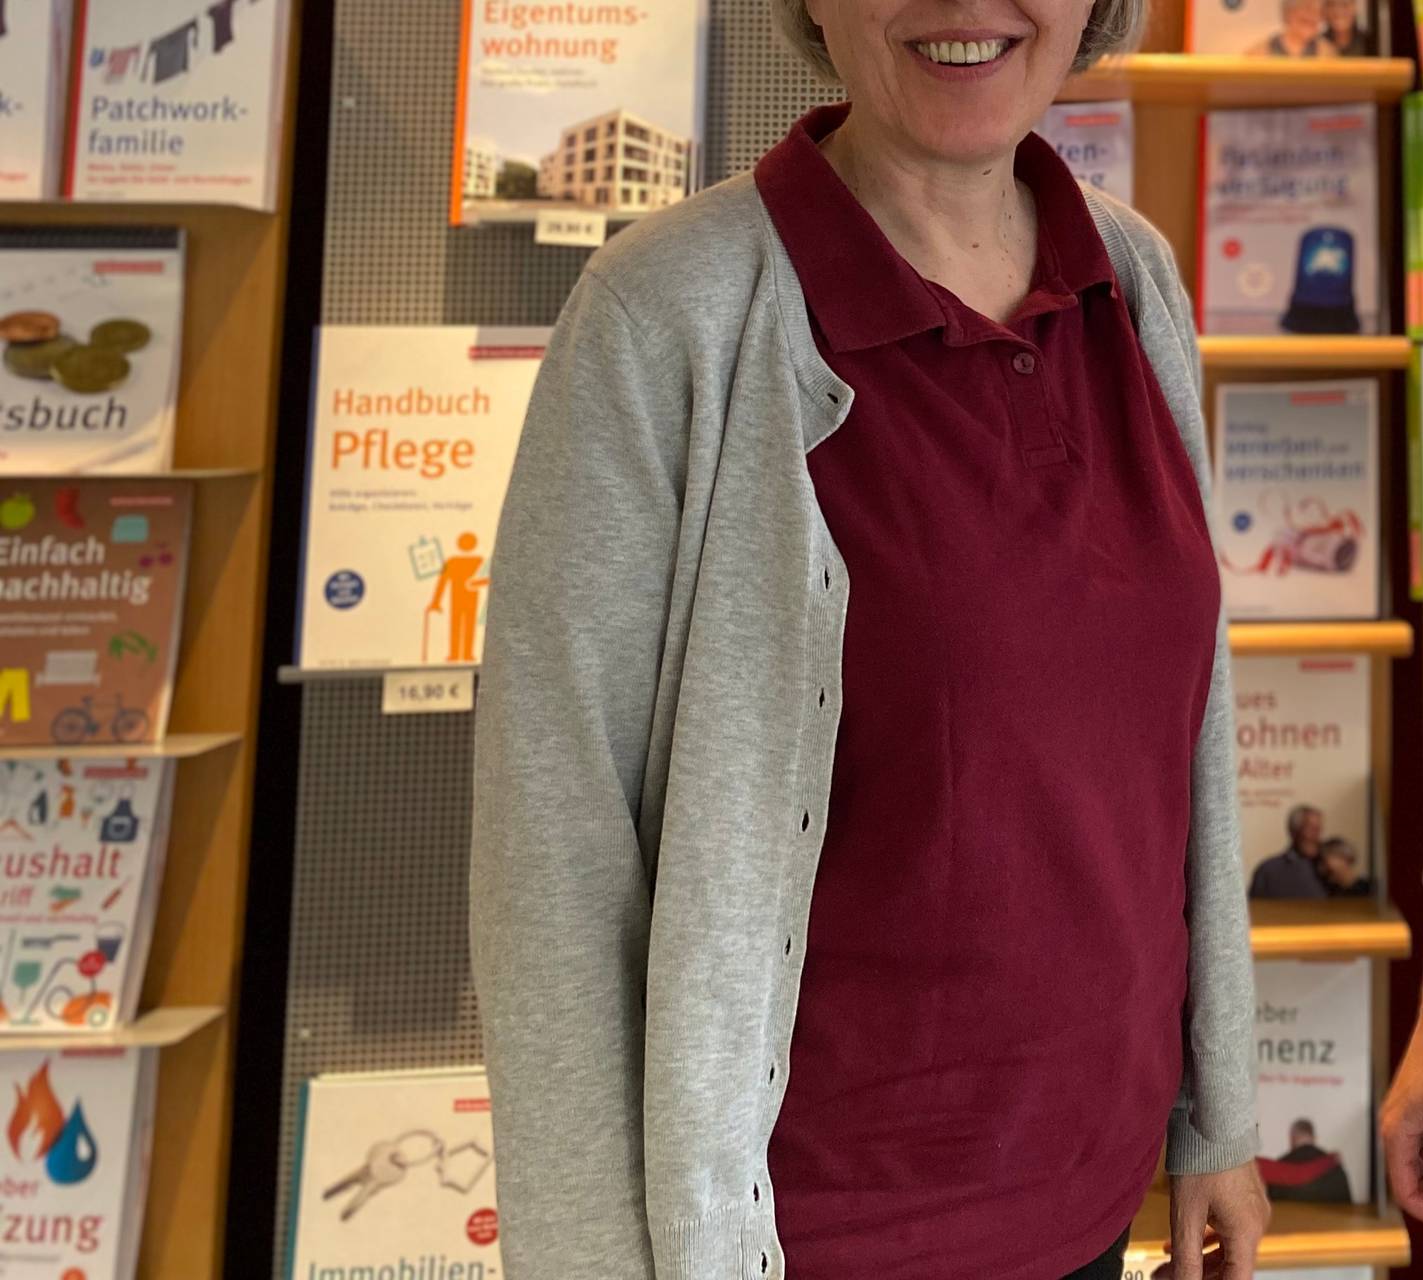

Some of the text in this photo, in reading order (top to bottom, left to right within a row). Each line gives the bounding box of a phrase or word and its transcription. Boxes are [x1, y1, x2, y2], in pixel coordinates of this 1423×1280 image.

[483, 0, 648, 29] Eigentums-
[480, 32, 619, 64] wohnung
[91, 95, 248, 121] Patchwork-
[88, 129, 183, 156] familie
[0, 396, 128, 431] sbuch
[331, 387, 490, 416] Handbuch
[330, 430, 476, 480] Pflege
[0, 534, 106, 566] Einfach
[1236, 717, 1341, 749] ohnen
[1239, 757, 1293, 780] Alter
[1258, 1038, 1337, 1065] nenz
[0, 1174, 39, 1198] ber
[2, 1213, 104, 1254] zung
